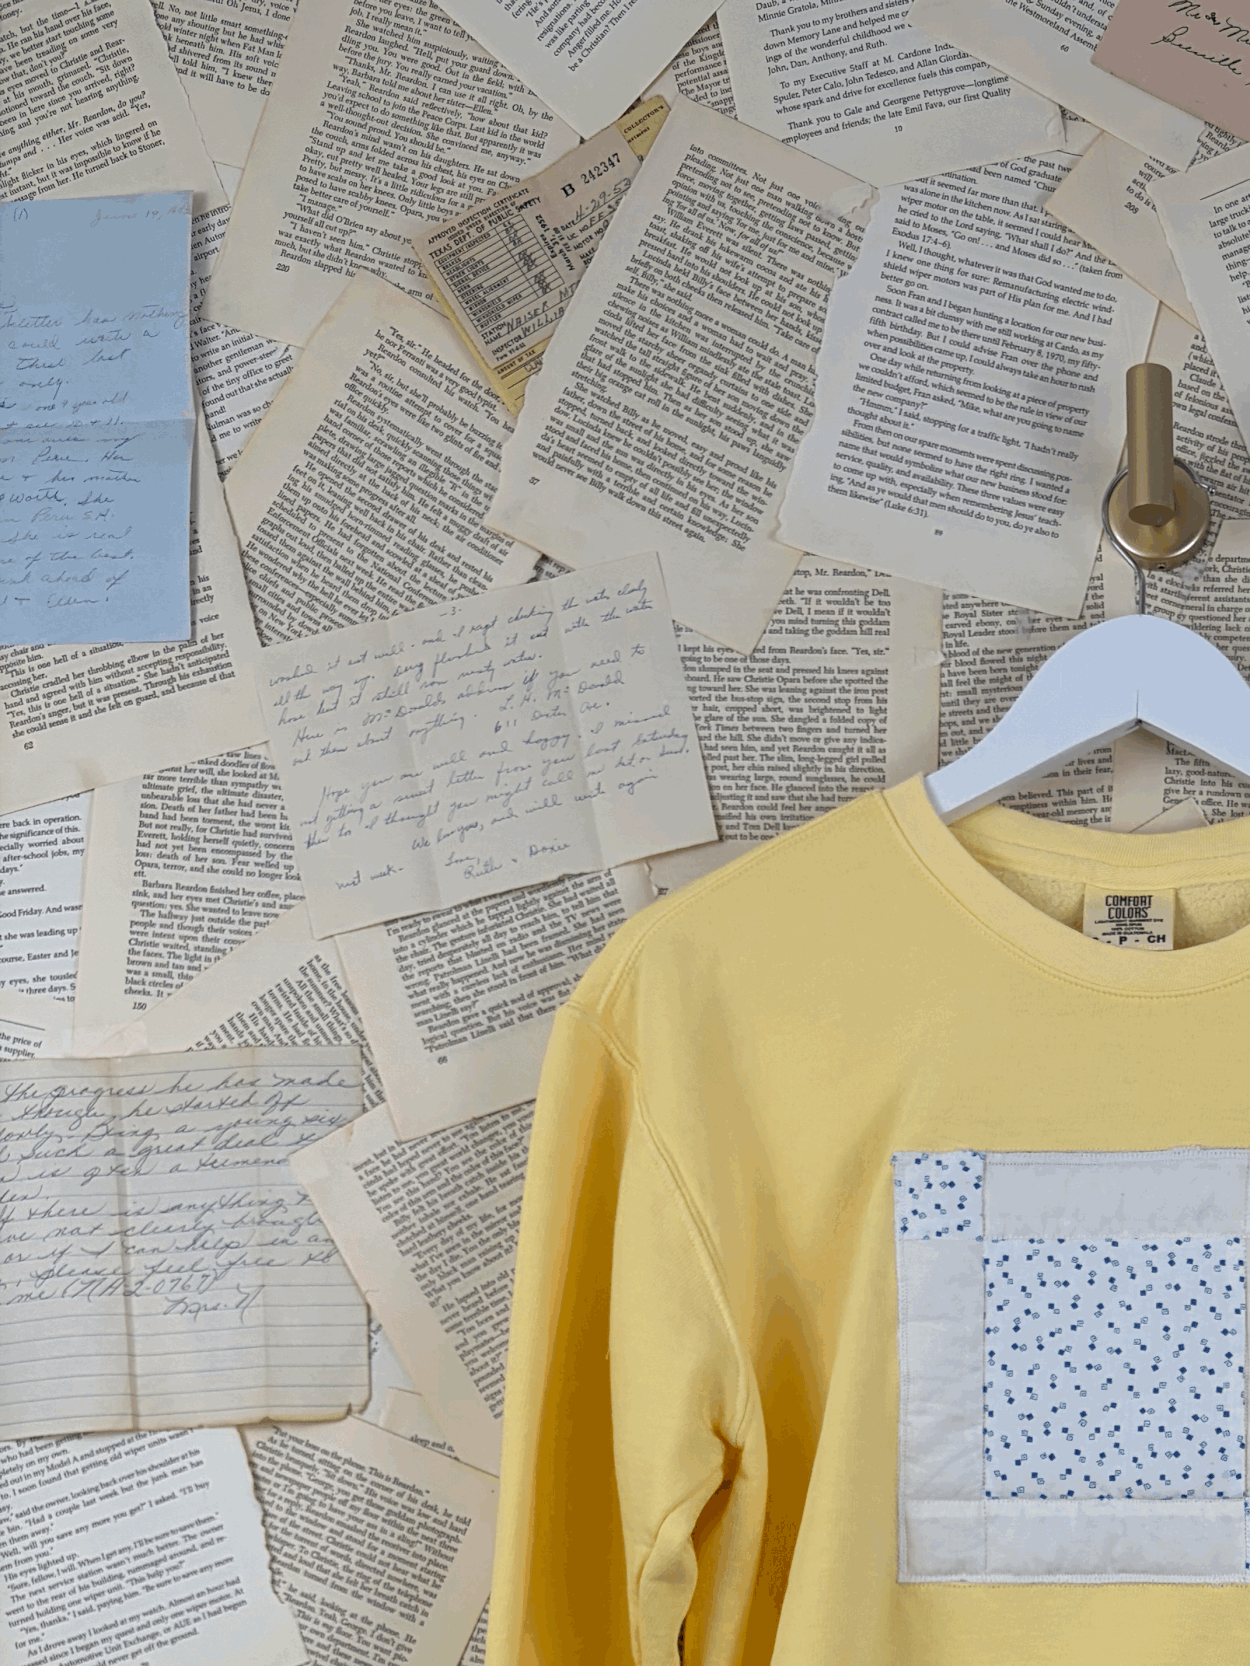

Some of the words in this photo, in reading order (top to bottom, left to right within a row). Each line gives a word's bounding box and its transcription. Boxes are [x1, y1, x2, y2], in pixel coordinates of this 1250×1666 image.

[894, 125, 903, 133] 10
[561, 184, 576, 198] B
[581, 153, 622, 184] 242347
[428, 242, 453, 260] TEXAS
[453, 231, 475, 247] DEPT.
[475, 223, 485, 234] OF
[487, 208, 515, 227] PUBLIC
[529, 476, 540, 486] 37
[883, 499, 907, 512] (Luke
[907, 505, 929, 519] 6:31).
[24, 740, 33, 750] 62
[1106, 895, 1153, 906] COMFORT
[1108, 907, 1149, 919] COLORS
[1147, 934, 1166, 944] CH
[132, 1001, 147, 1011] 150
[3, 1572, 19, 1583] His
[19, 1566, 37, 1578] eyes
[36, 1555, 66, 1572] lighted
[65, 1553, 80, 1562] up.
